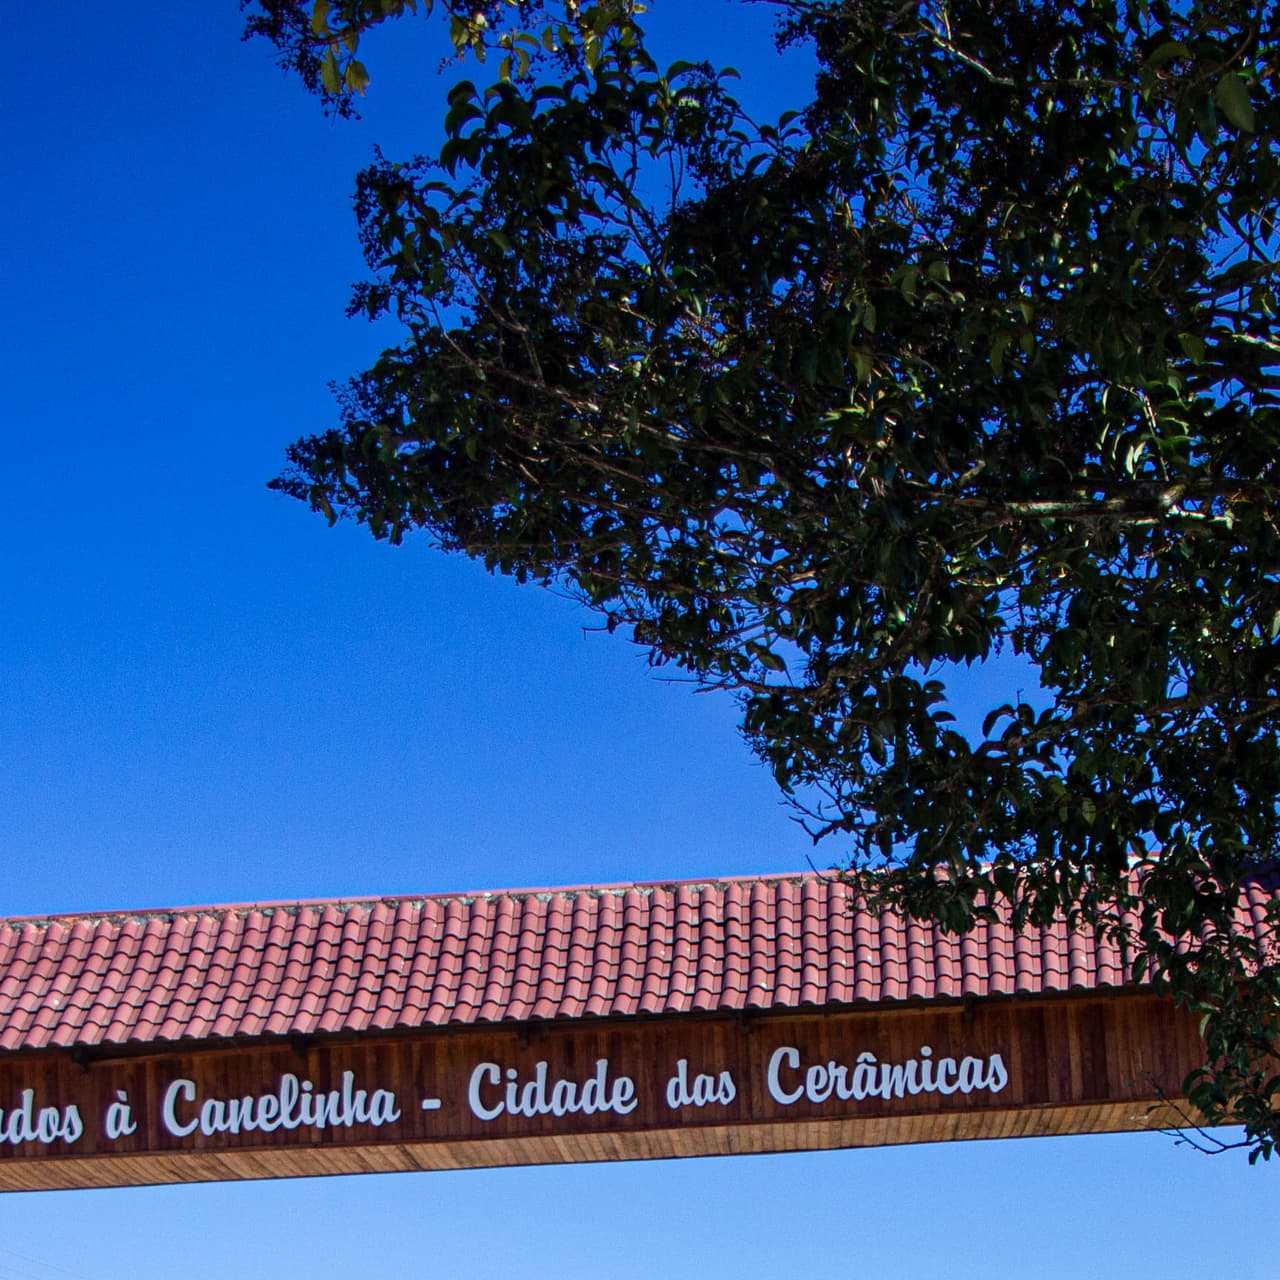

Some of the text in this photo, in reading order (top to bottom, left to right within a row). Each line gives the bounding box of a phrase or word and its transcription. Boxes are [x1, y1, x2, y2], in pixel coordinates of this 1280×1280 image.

[105, 1089, 138, 1140] à
[161, 1069, 402, 1138] Canelinha
[467, 1061, 639, 1121] Cidade
[665, 1057, 737, 1110] das
[766, 1044, 1009, 1106] Cerâmicas
